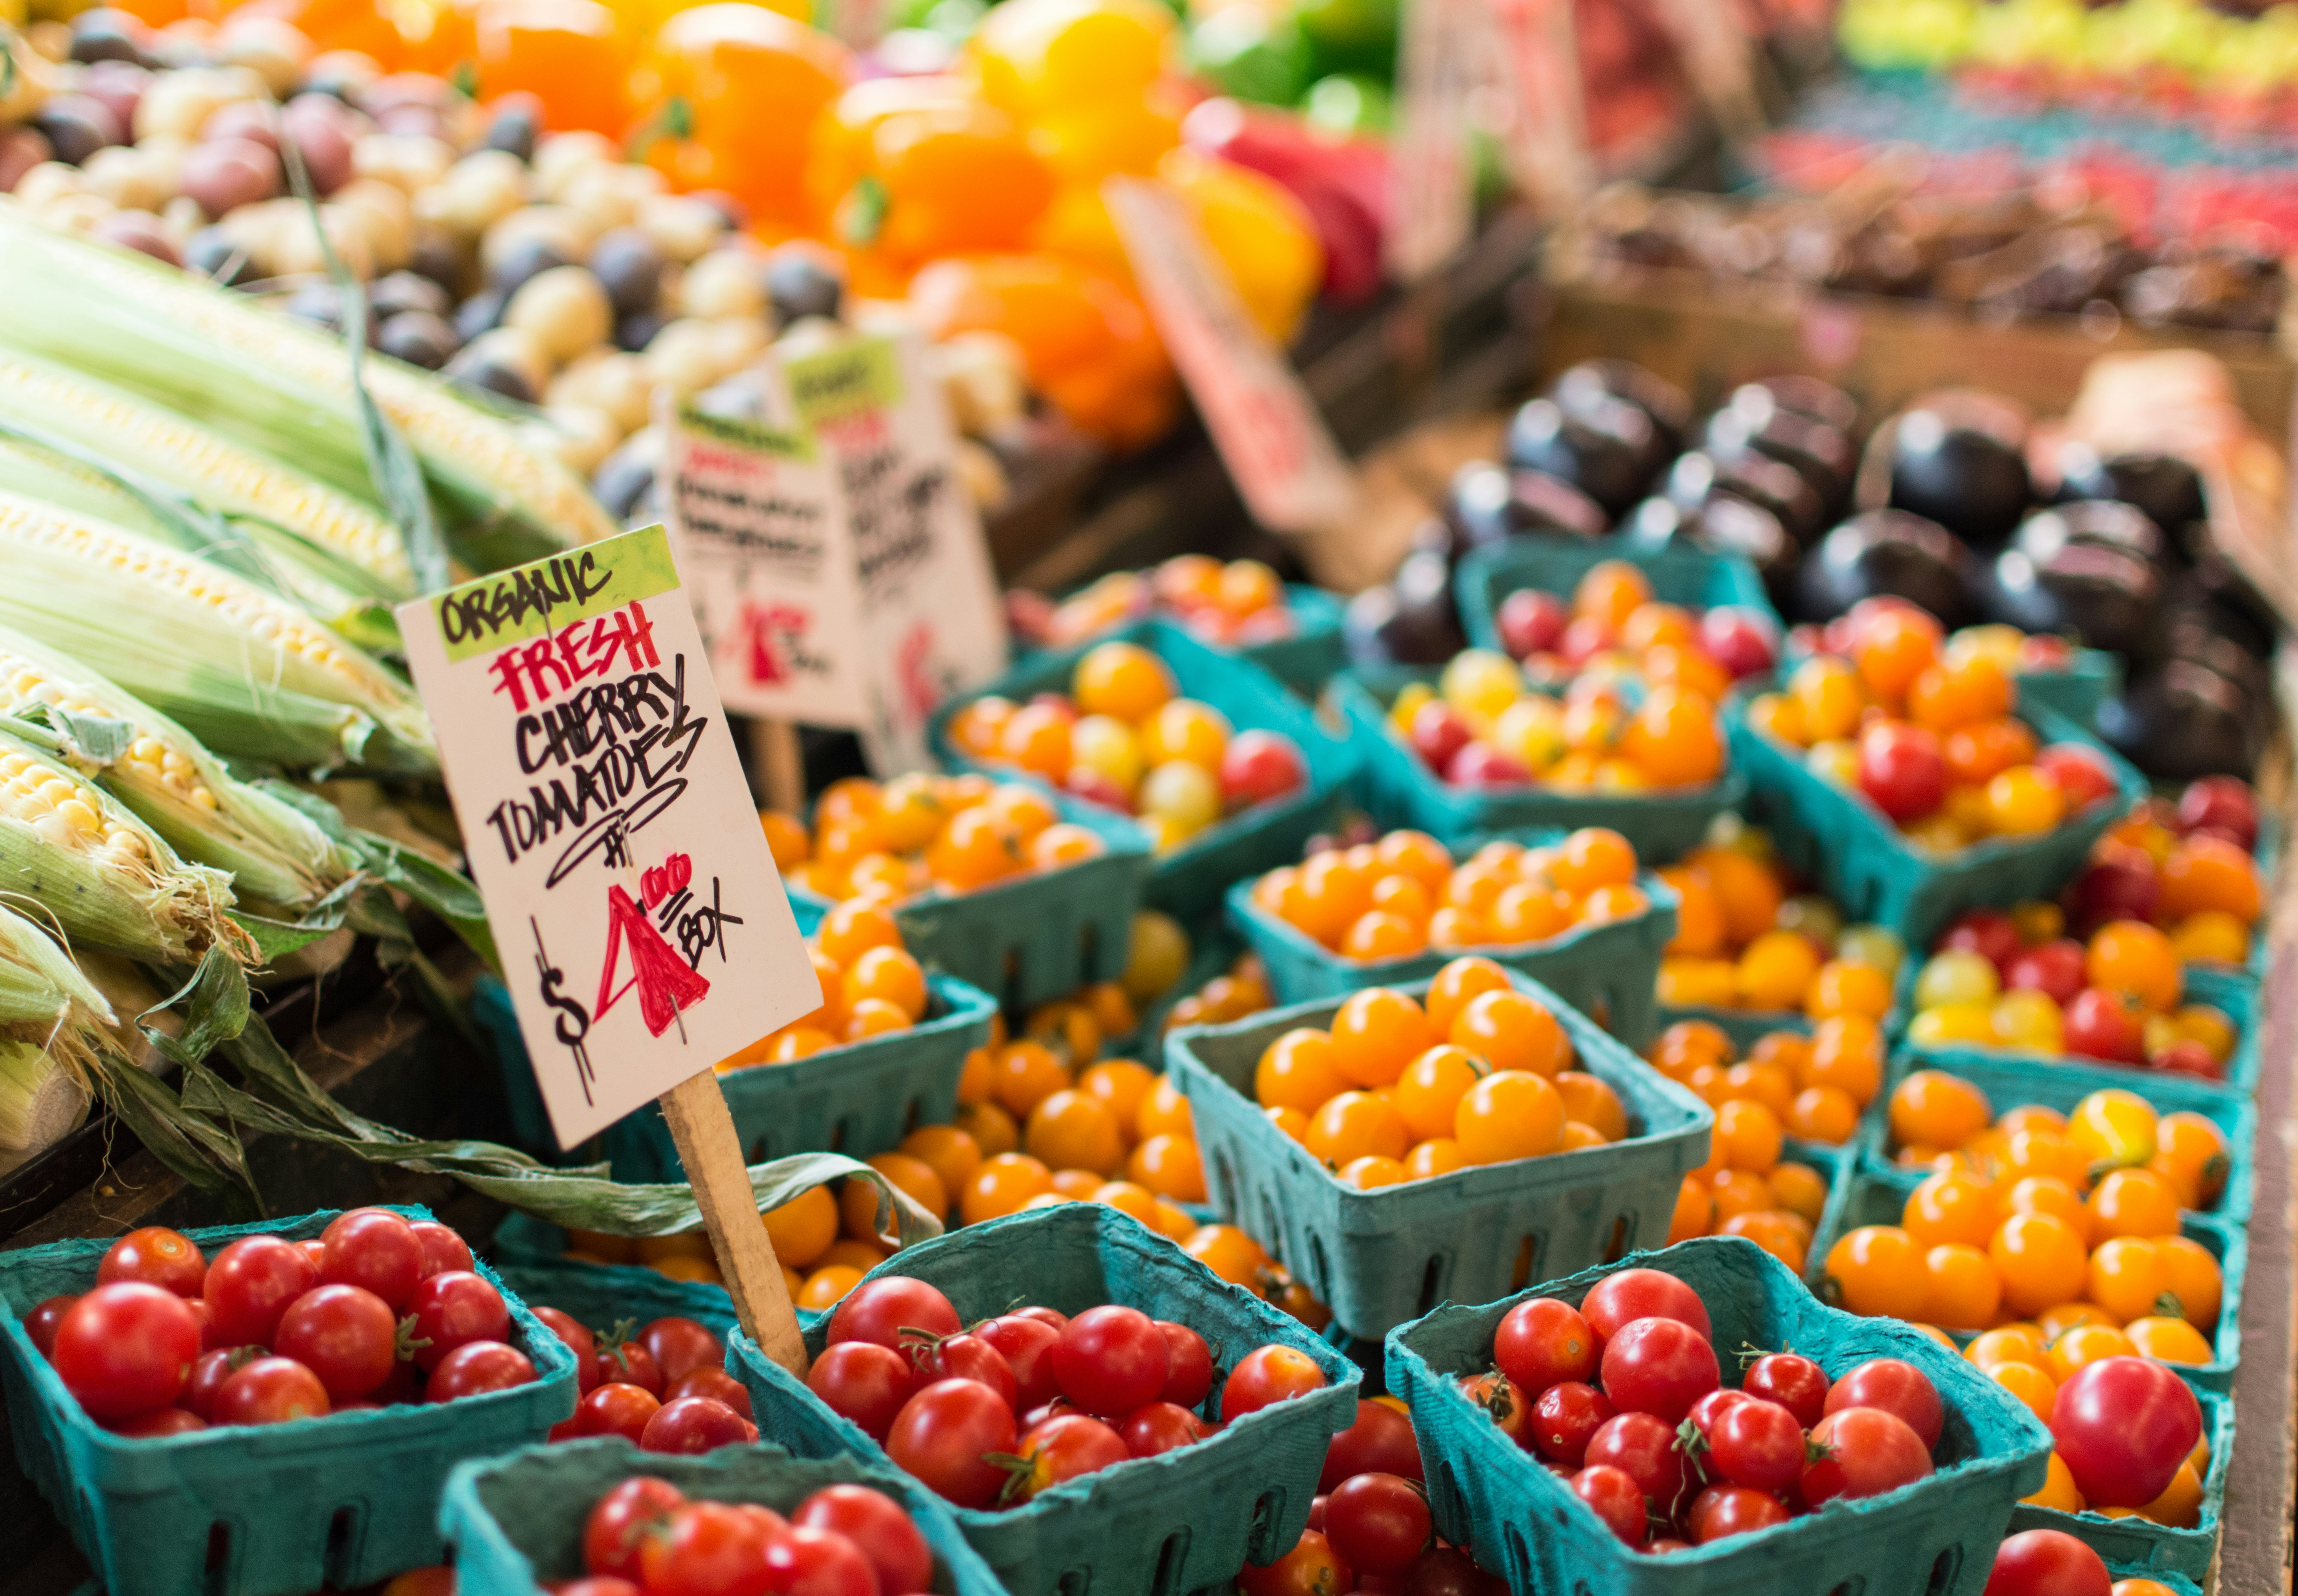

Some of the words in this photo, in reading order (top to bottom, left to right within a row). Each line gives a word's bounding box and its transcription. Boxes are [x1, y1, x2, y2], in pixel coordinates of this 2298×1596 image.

[440, 551, 613, 645] ORGANIC
[488, 600, 663, 713] FRESH
[515, 653, 684, 775] CHERRY
[486, 705, 708, 863] TOMATOES
[676, 876, 743, 971] BOX
